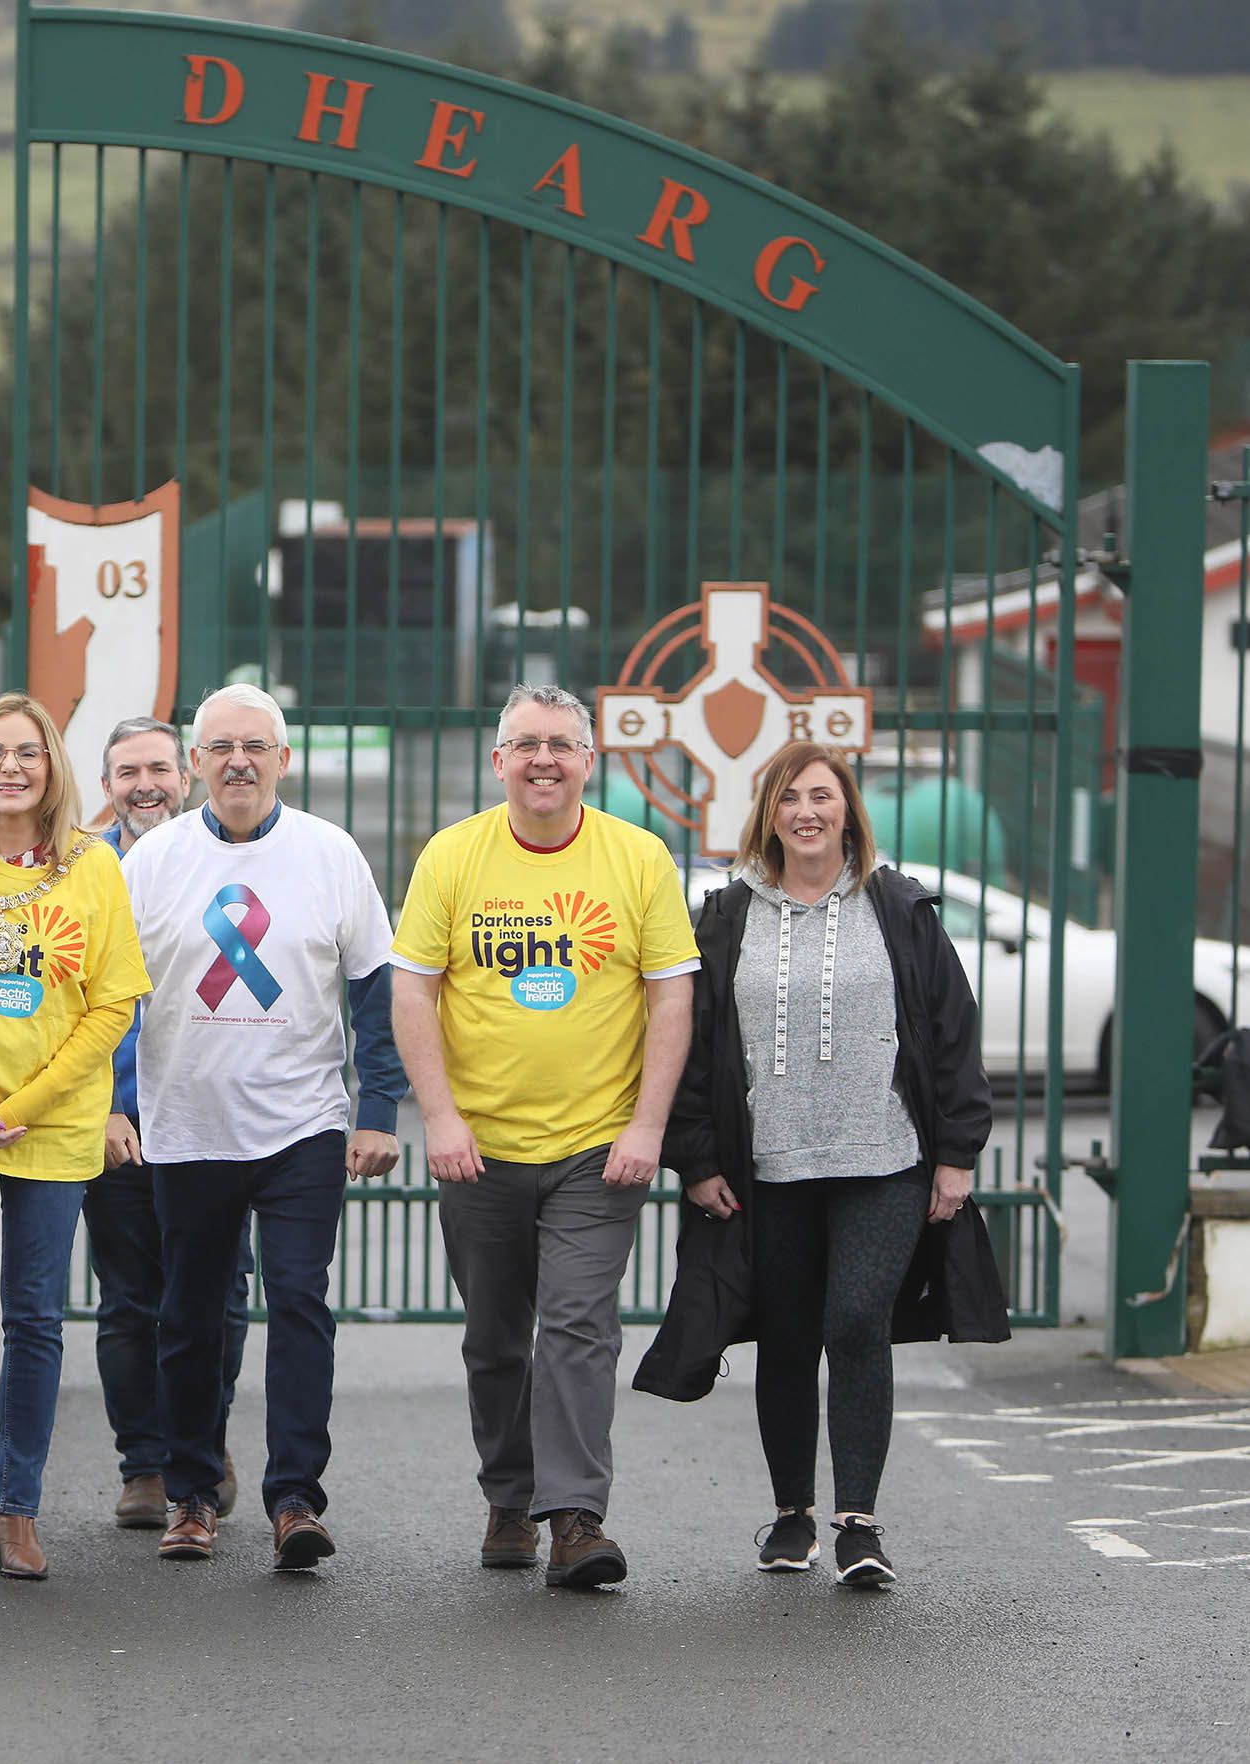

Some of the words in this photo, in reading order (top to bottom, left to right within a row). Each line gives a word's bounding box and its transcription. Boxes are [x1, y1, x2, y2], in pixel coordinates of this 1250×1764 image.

[181, 54, 827, 312] DHEARG
[97, 560, 148, 598] 03
[484, 897, 524, 912] pieta
[472, 913, 552, 927] Darkness
[500, 929, 523, 939] into
[472, 930, 572, 978] light
[518, 980, 564, 991] electric
[526, 990, 564, 1002] Ireland
